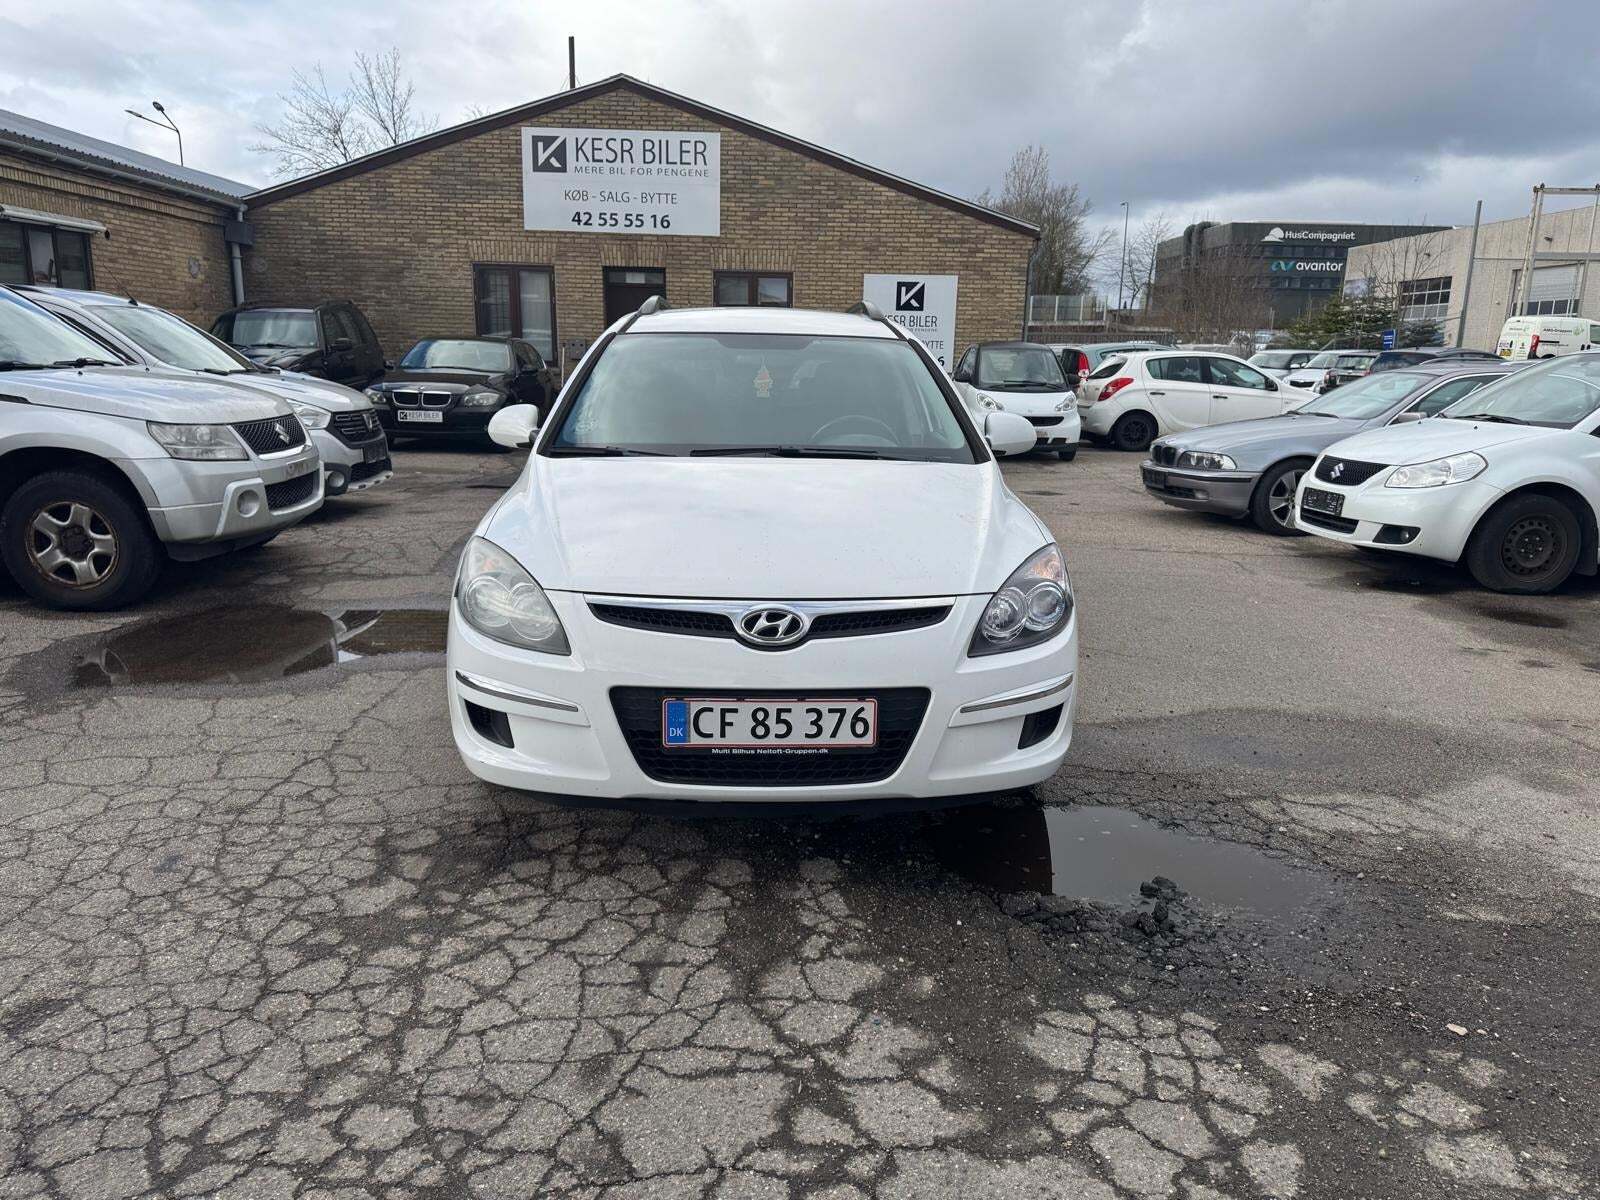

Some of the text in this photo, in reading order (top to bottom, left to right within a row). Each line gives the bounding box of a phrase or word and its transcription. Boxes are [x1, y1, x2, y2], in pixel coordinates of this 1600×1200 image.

[575, 137, 708, 166] KESR BILER
[574, 166, 710, 177] MERE BIL FOR PENGENE
[564, 189, 589, 201] KØB
[599, 191, 630, 203] SALG
[640, 192, 678, 205] BYTTE
[571, 211, 671, 229] 42 55 55 16
[1285, 230, 1356, 242] HusCompagniet
[1296, 260, 1344, 271] avantor
[909, 315, 938, 328] BILER
[921, 340, 944, 349] YTTE
[692, 706, 870, 740] CF 85 376
[669, 727, 684, 737] DK
